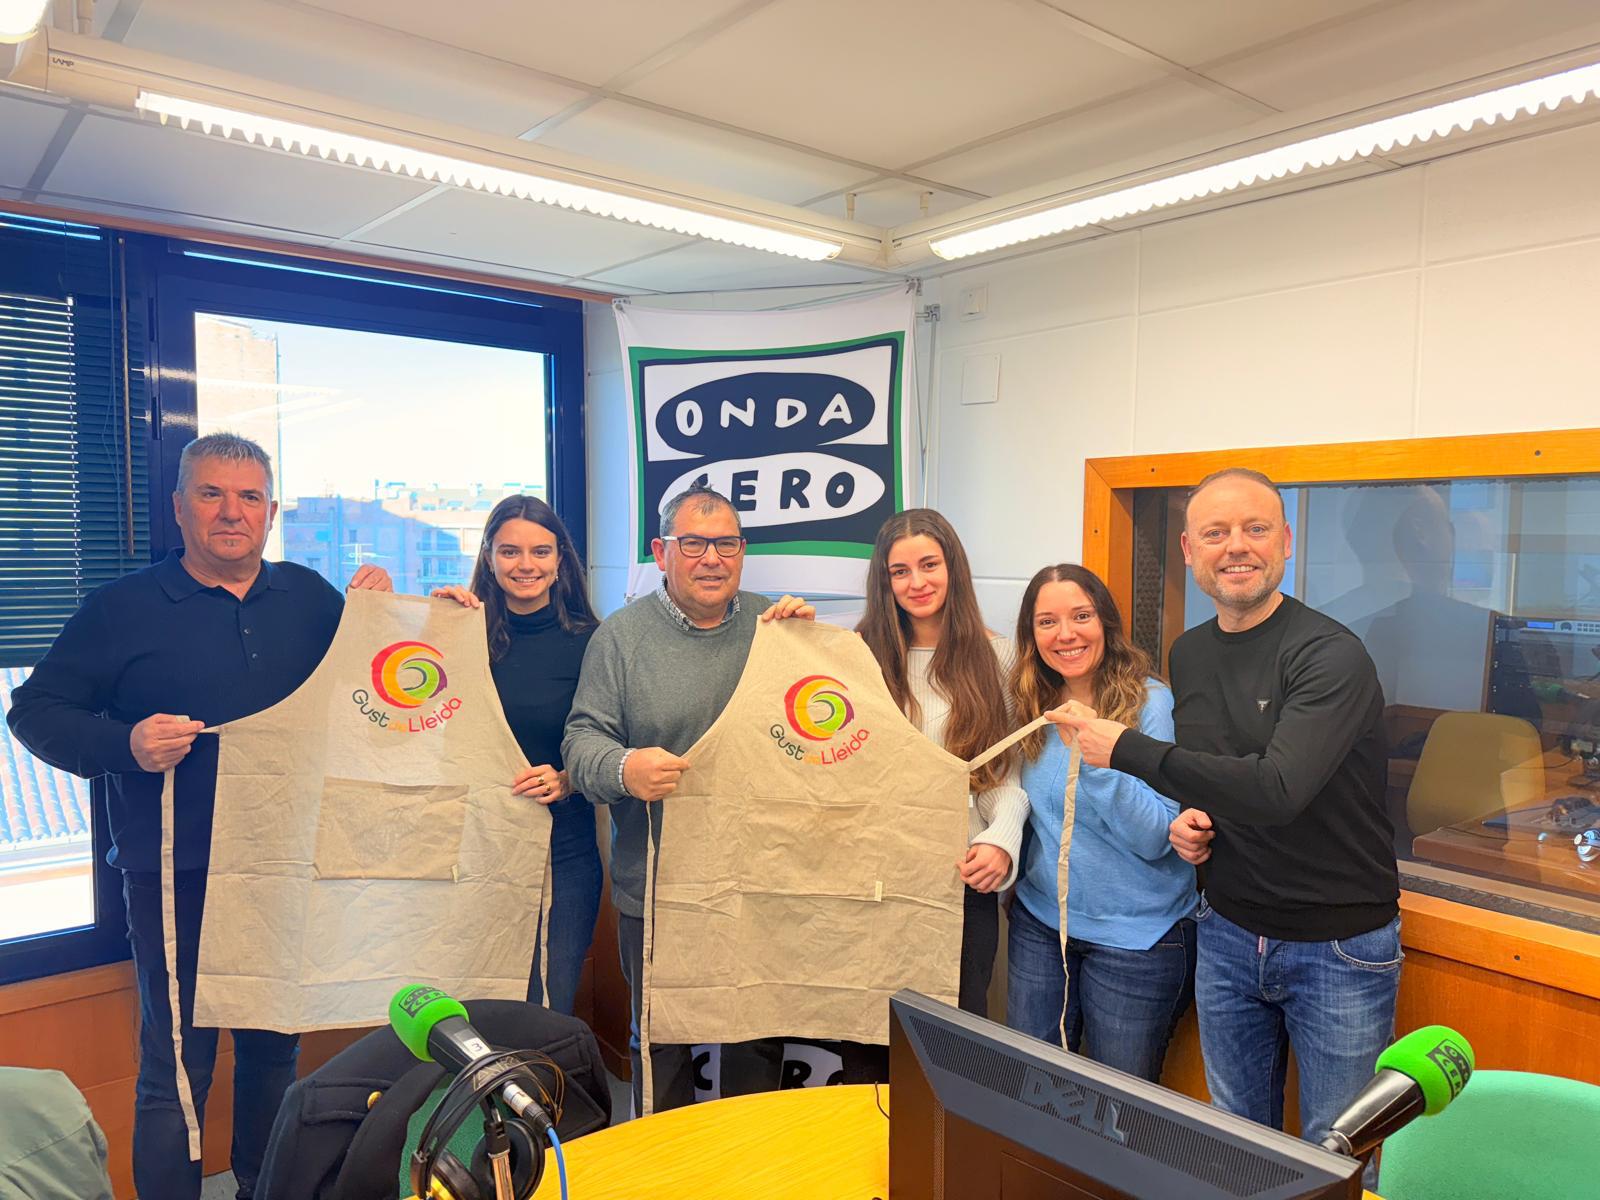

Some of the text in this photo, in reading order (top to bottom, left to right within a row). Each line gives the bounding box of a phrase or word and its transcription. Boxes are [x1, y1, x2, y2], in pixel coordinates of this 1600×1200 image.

[675, 393, 852, 437] ONDA
[352, 689, 390, 728] Gust
[408, 697, 463, 732] Lleida
[770, 724, 805, 761] Gust
[821, 729, 870, 765] Lleida
